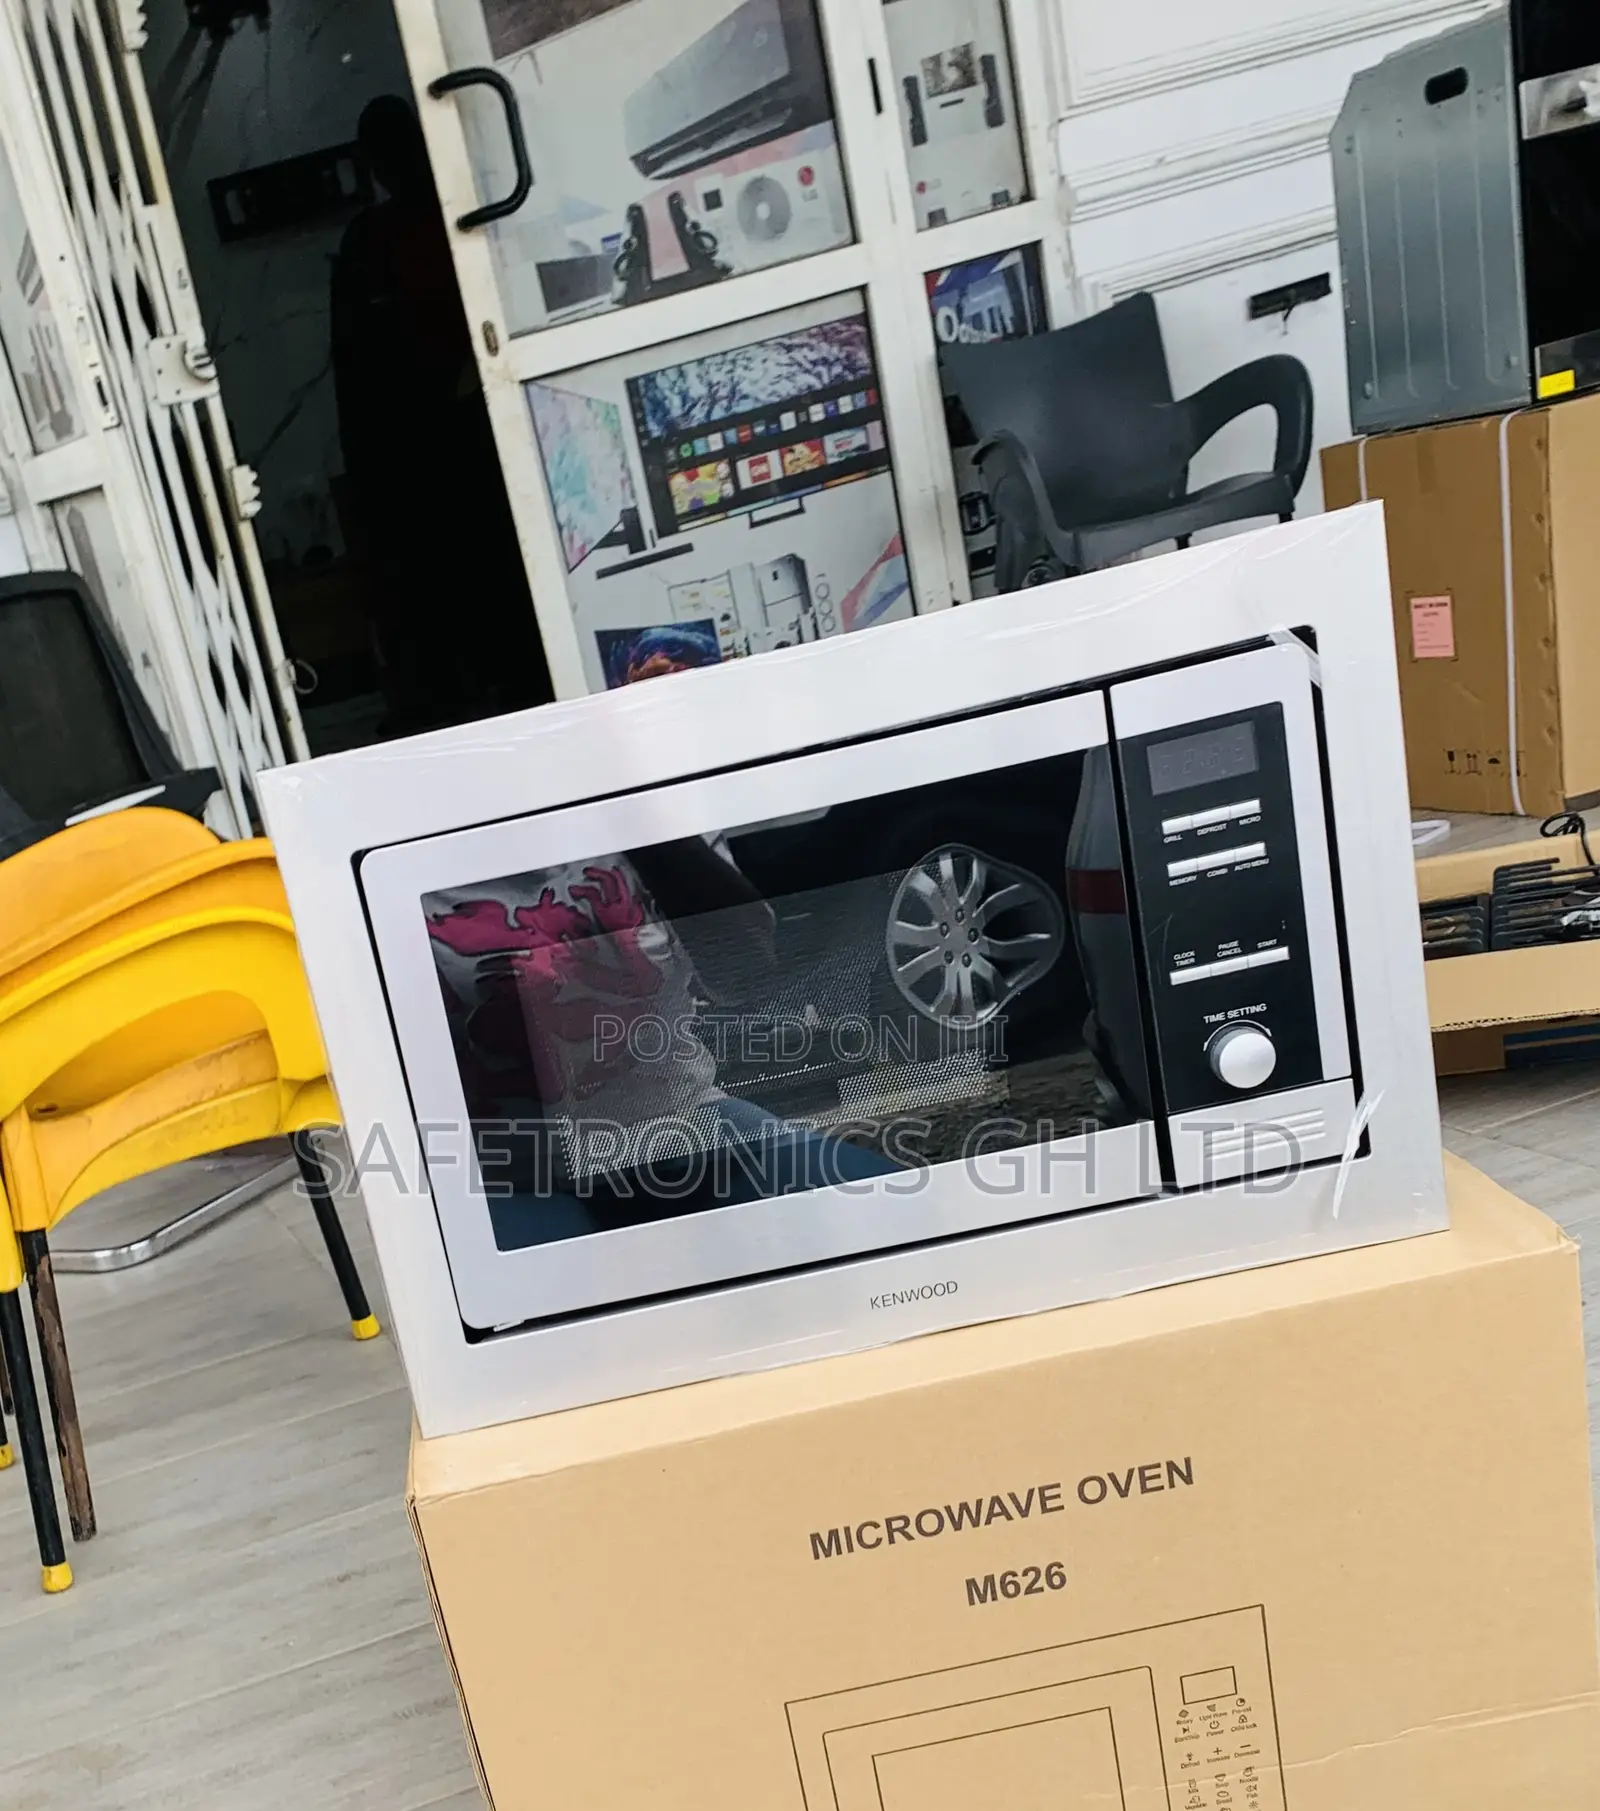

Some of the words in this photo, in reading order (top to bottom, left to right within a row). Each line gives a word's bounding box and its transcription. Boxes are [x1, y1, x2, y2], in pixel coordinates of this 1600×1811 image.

[1173, 950, 1196, 960] CLOCK
[1216, 947, 1243, 957] CANCEL
[1203, 1011, 1226, 1024] TIME
[1226, 1003, 1268, 1019] SETTING
[870, 1280, 959, 1310] KENWOOD
[809, 1481, 1065, 1561] MICROWAVE
[1076, 1456, 1195, 1506] OVEN
[965, 1561, 1067, 1607] M626
